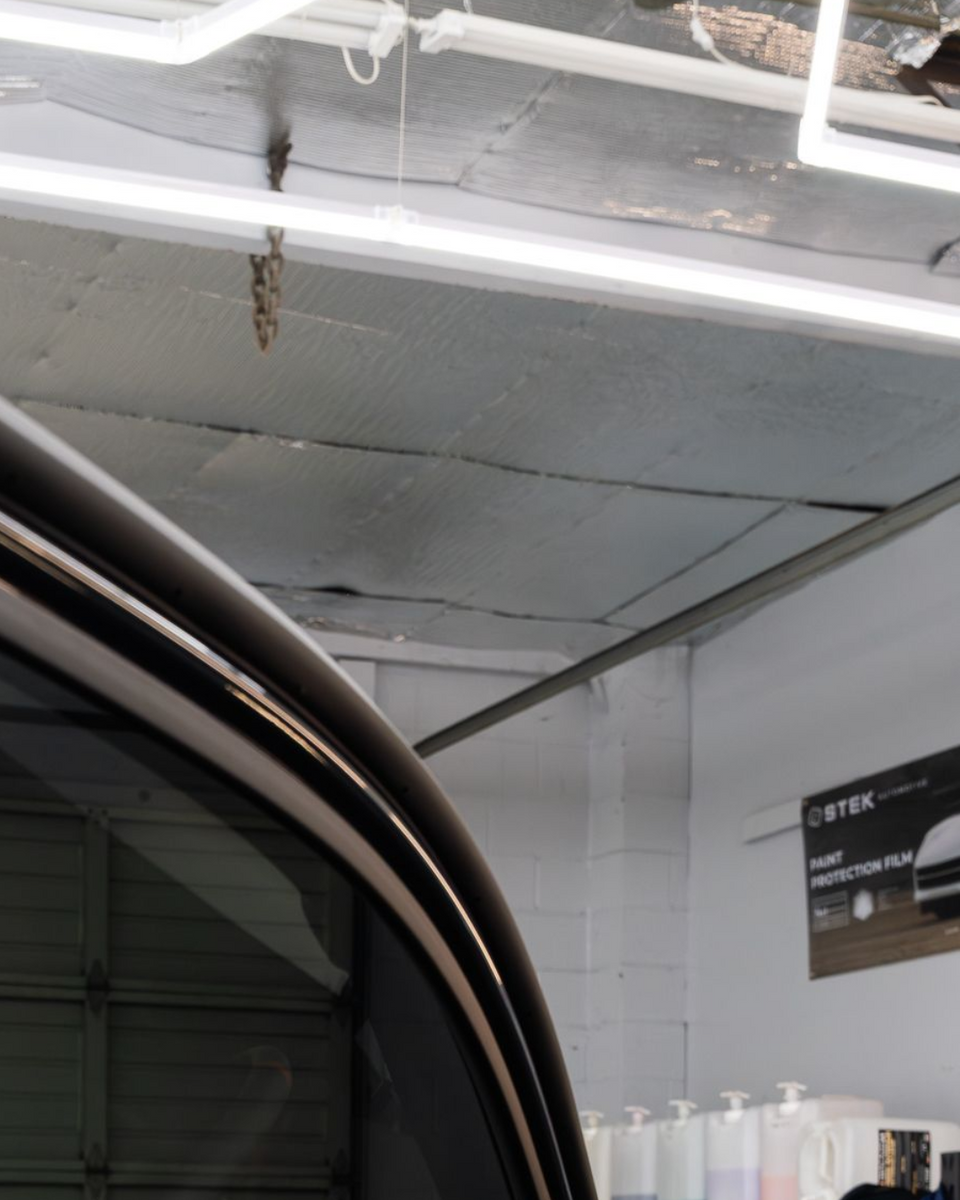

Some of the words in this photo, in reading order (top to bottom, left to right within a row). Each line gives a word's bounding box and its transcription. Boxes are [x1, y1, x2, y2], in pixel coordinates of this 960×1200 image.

[824, 790, 875, 822] STEK
[810, 850, 843, 872] PAINT
[811, 859, 882, 889] PROTECTION
[884, 850, 913, 870] FILM
